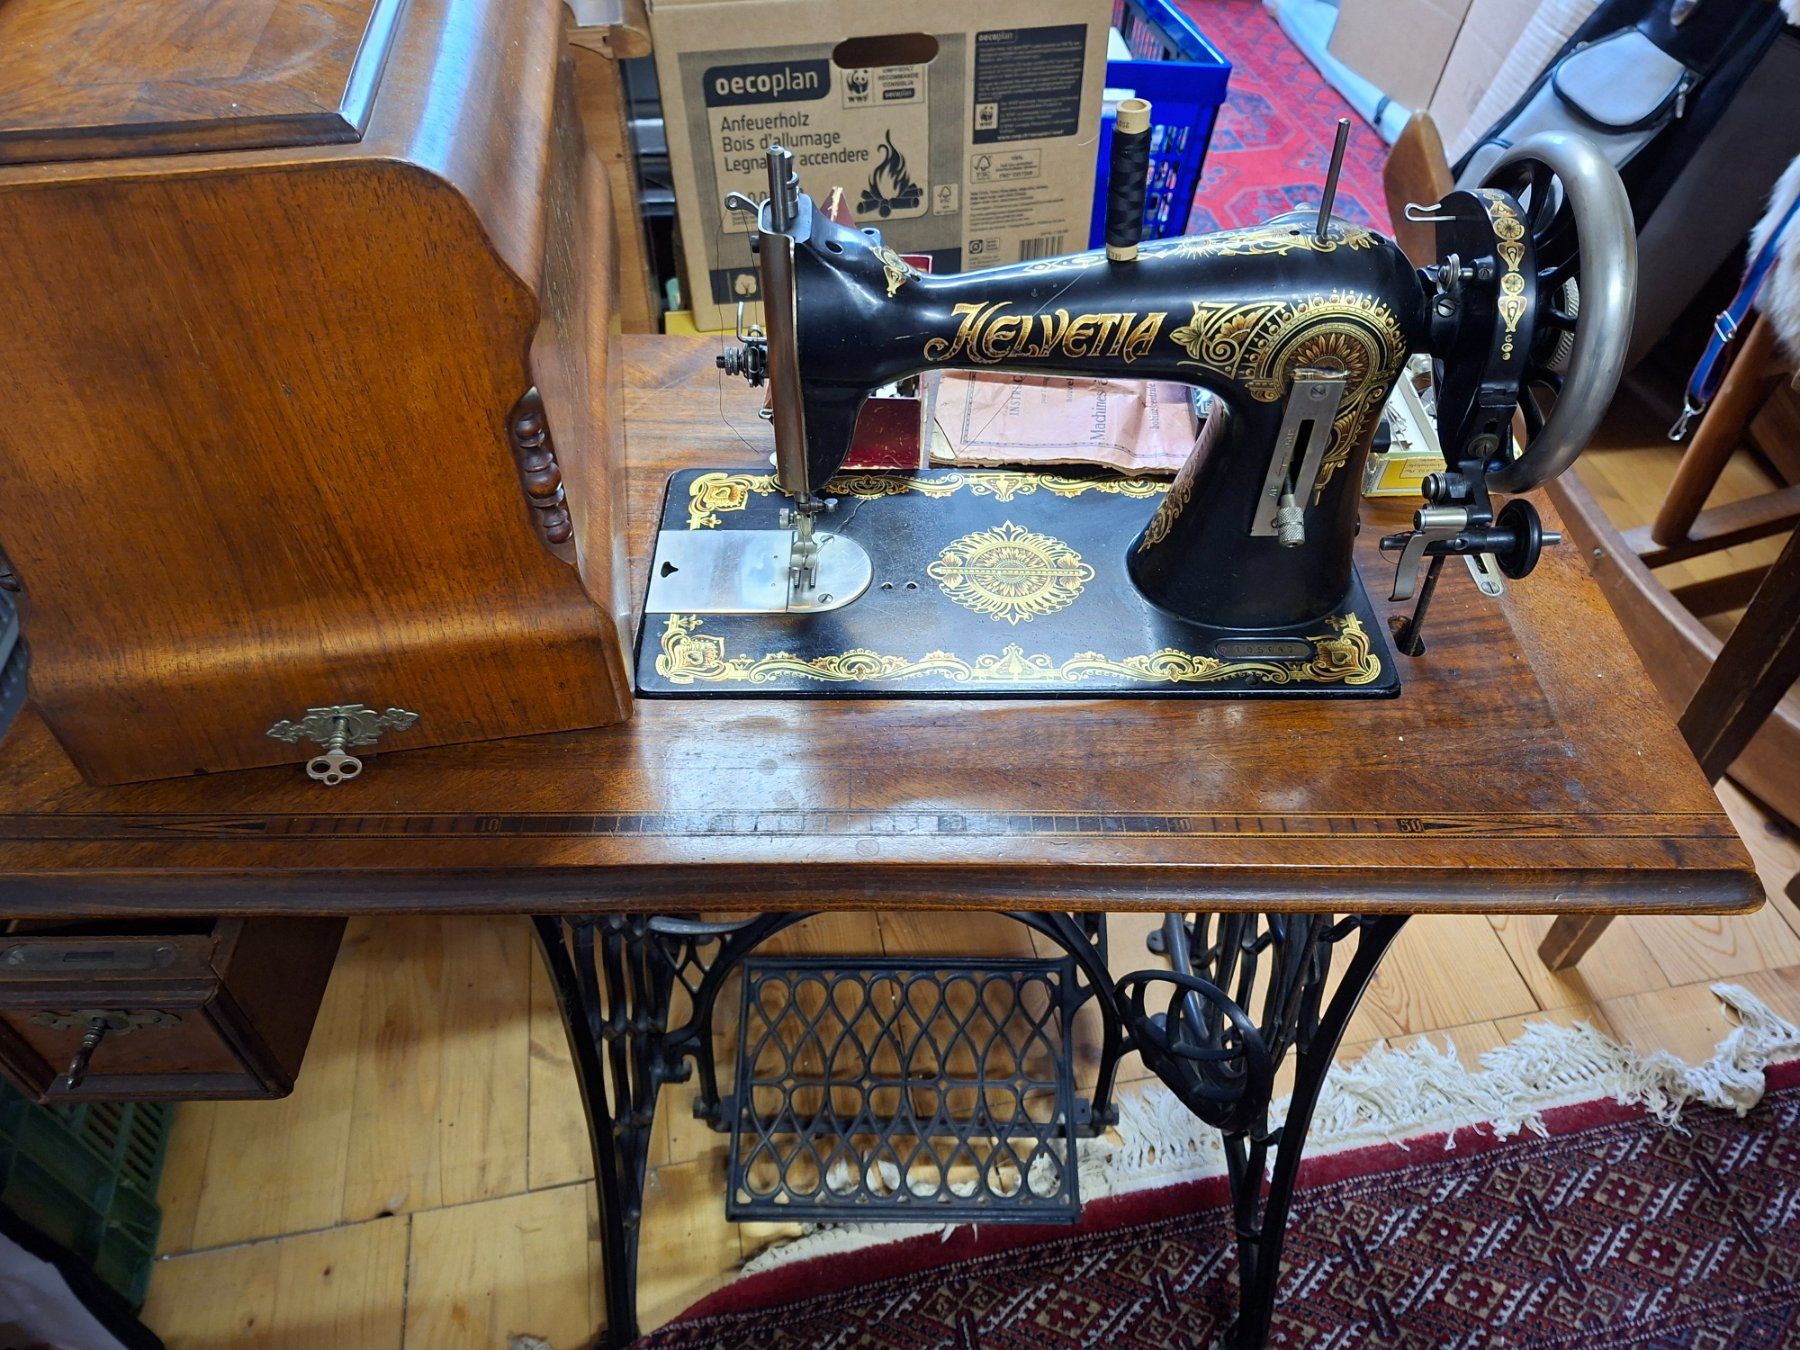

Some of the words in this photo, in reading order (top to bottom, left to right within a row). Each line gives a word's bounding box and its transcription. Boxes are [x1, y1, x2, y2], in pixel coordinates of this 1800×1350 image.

[715, 67, 818, 97] oecoplan
[721, 111, 810, 132] Anfeuerholz
[722, 136, 755, 153] Bois
[760, 131, 841, 149] d'allumage
[725, 157, 767, 174] Legna
[800, 148, 869, 166] accendere
[923, 300, 1168, 364] HELVETIA
[1089, 391, 1108, 440] Machines
